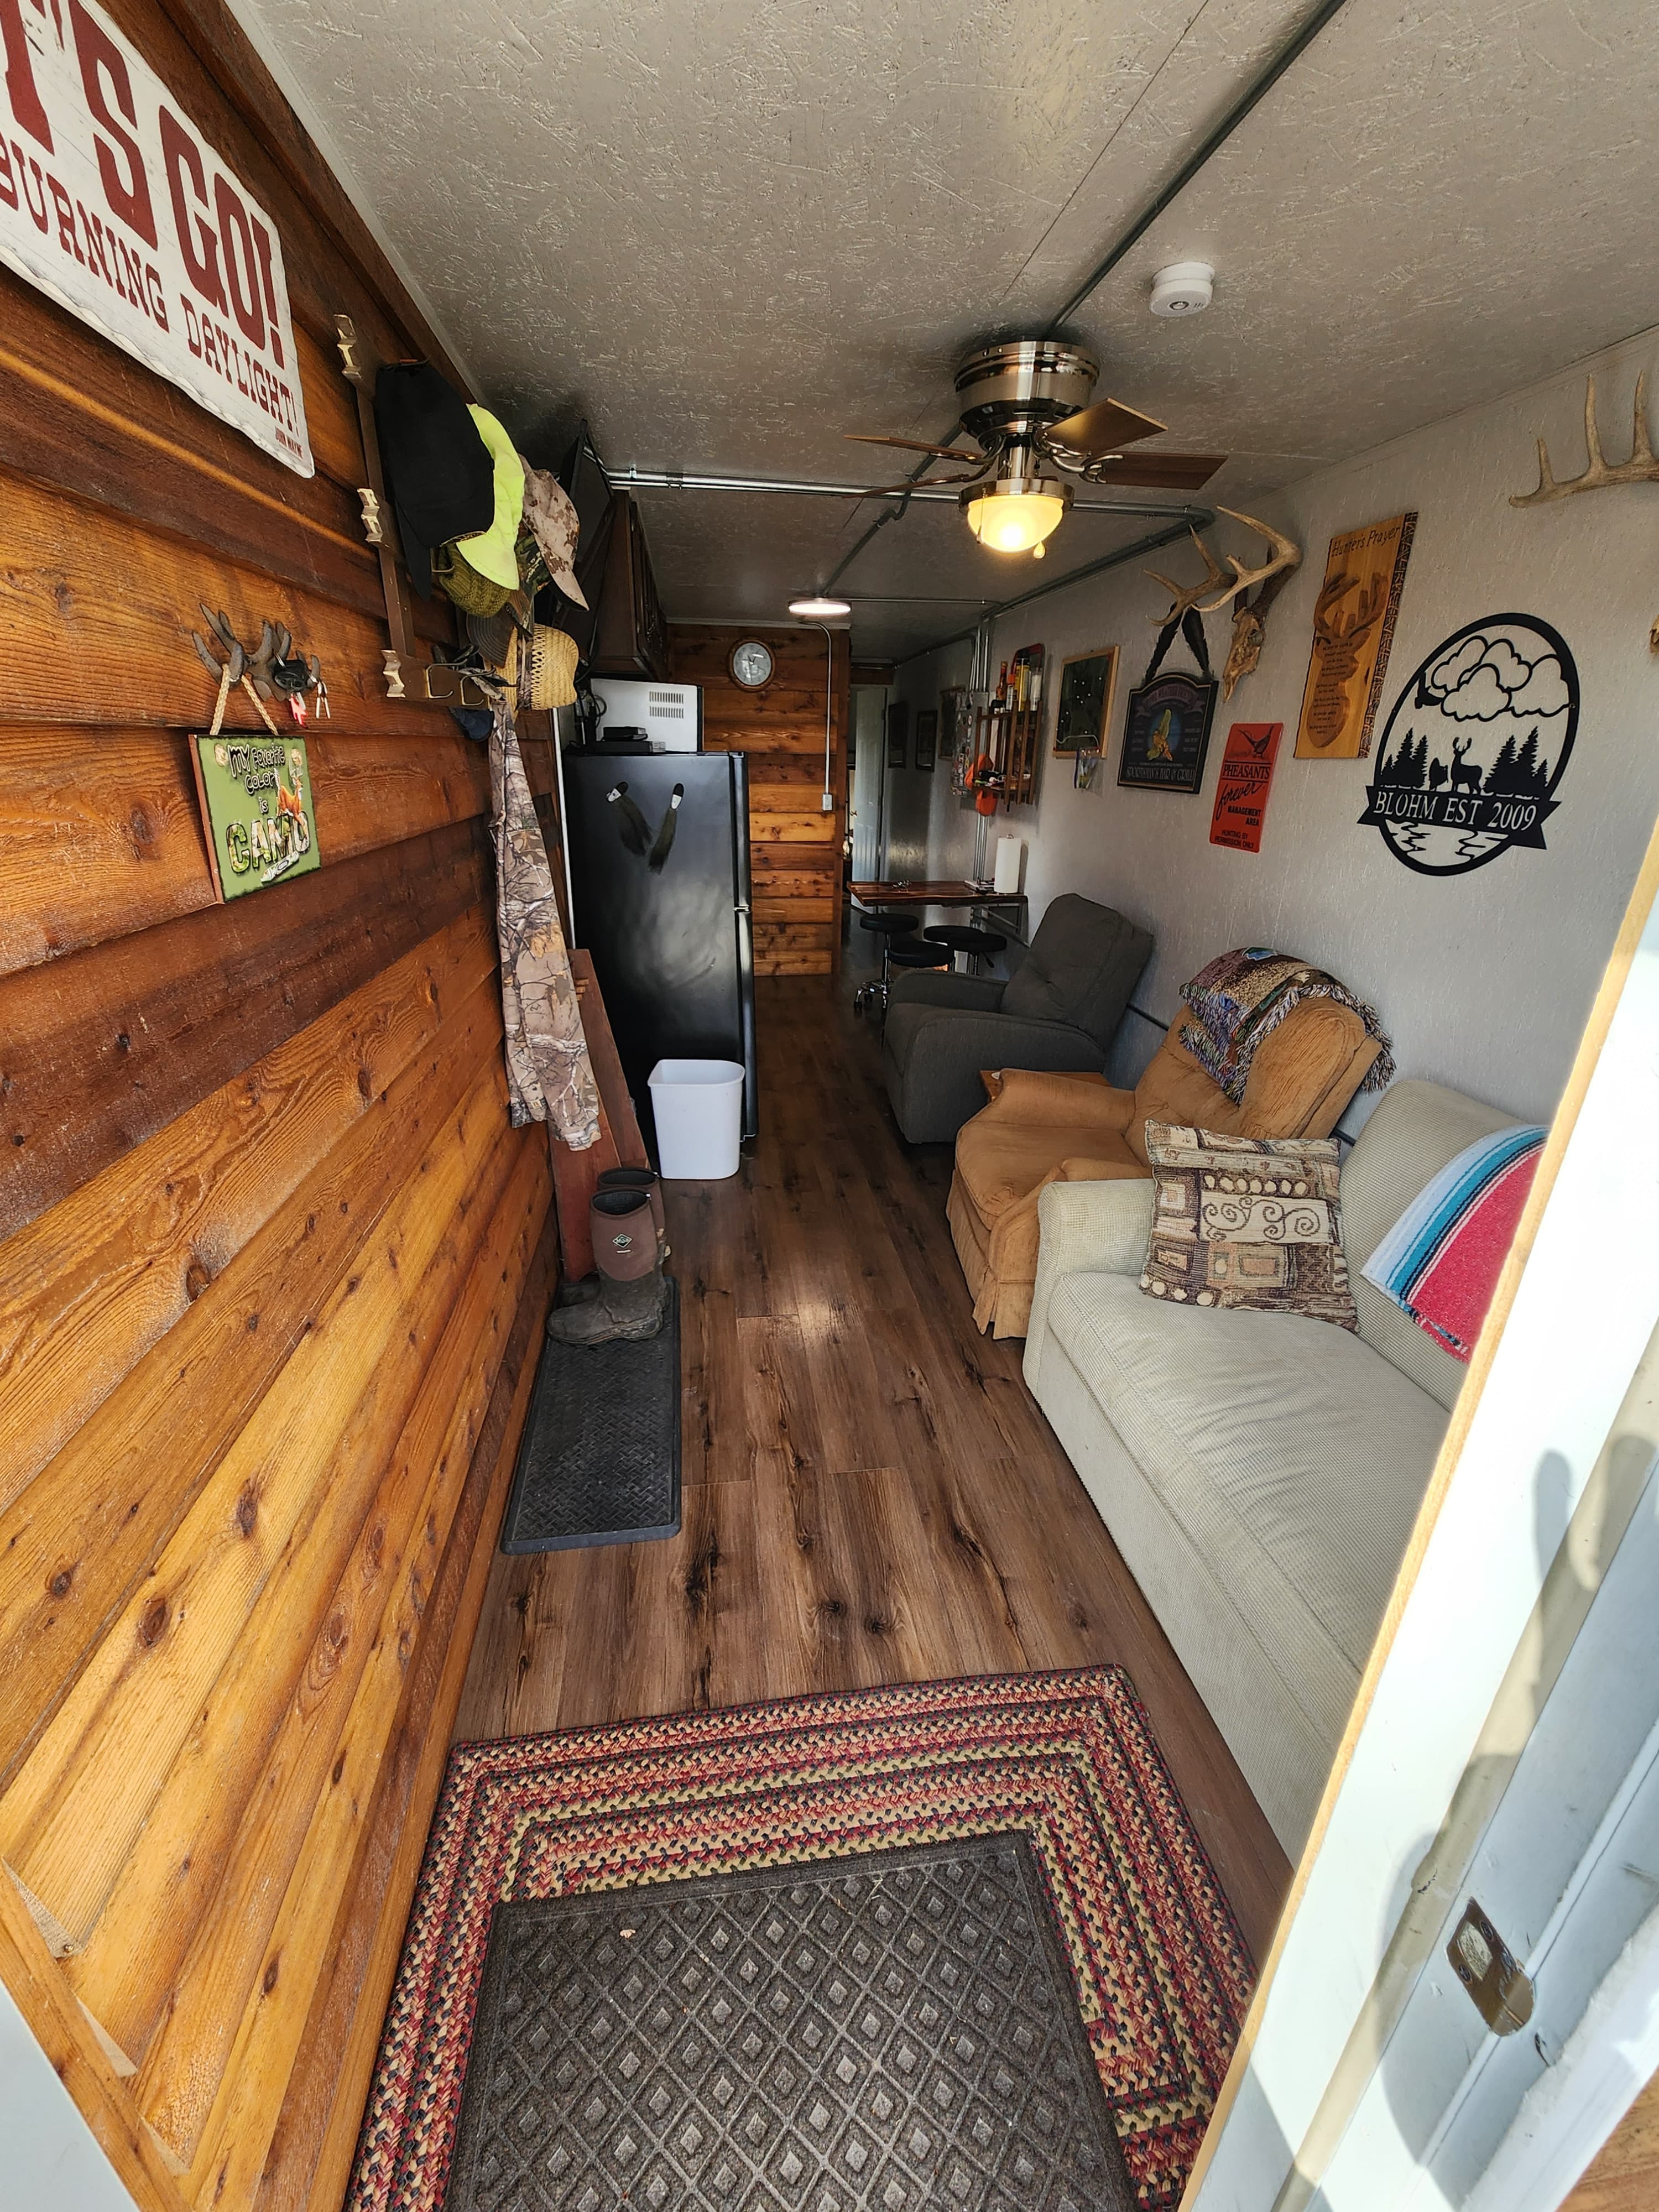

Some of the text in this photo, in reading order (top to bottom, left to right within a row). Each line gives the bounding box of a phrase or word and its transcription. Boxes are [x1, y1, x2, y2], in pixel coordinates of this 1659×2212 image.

[159, 105, 285, 370] GO!
[180, 292, 299, 437] DAYLIGHT!
[1331, 526, 1400, 557] Hunter's Prayer
[1223, 764, 1271, 780] PHEASANTS
[258, 796, 268, 813] is
[1216, 782, 1262, 821] forever
[1228, 805, 1261, 817] MANAGEMENT
[1374, 791, 1537, 831] BLOHM EST 2009
[1245, 818, 1259, 826] AREA
[226, 811, 310, 874] CAMO
[1215, 836, 1254, 848] PERMISSION ONLY
